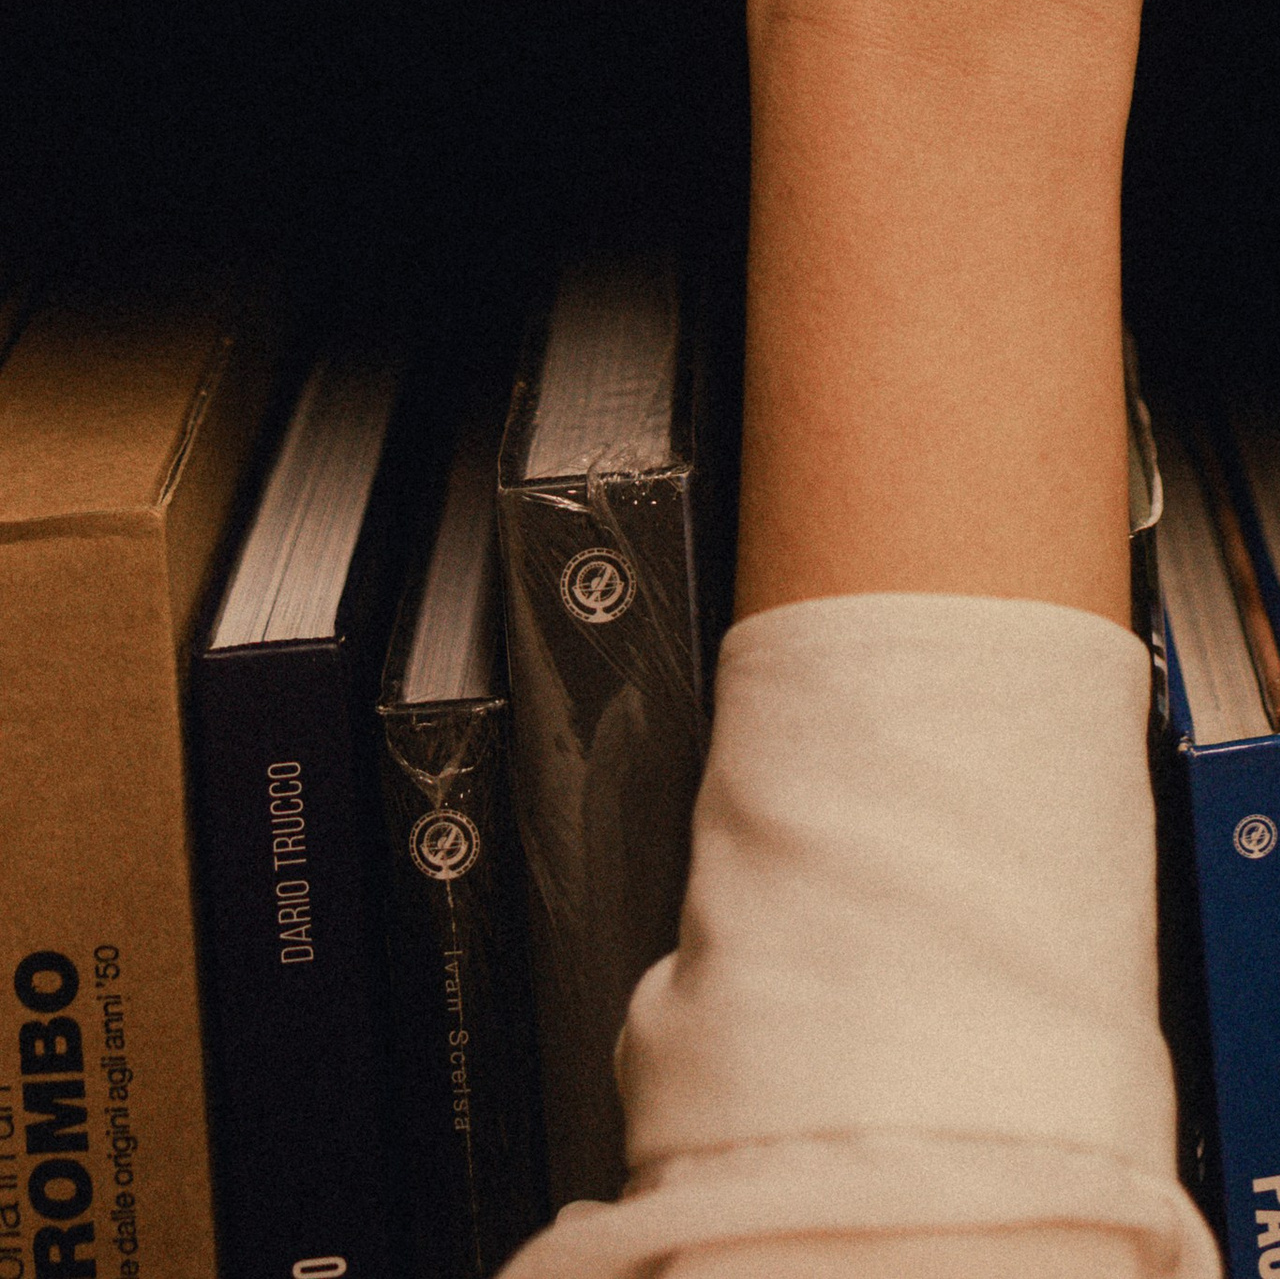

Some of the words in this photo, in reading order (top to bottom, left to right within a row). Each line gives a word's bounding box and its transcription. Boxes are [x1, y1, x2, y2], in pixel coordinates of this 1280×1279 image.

[268, 761, 308, 872] TRUCCO
[277, 879, 315, 965] DARIO
[94, 945, 120, 987] '50
[442, 949, 464, 1013] Ivan
[97, 995, 125, 1050] anni
[101, 1055, 132, 1102] agli
[447, 1029, 470, 1133] Scelsa
[14, 950, 97, 1279] ROMBO
[105, 1107, 137, 1186] origini
[111, 1193, 139, 1255] dalle
